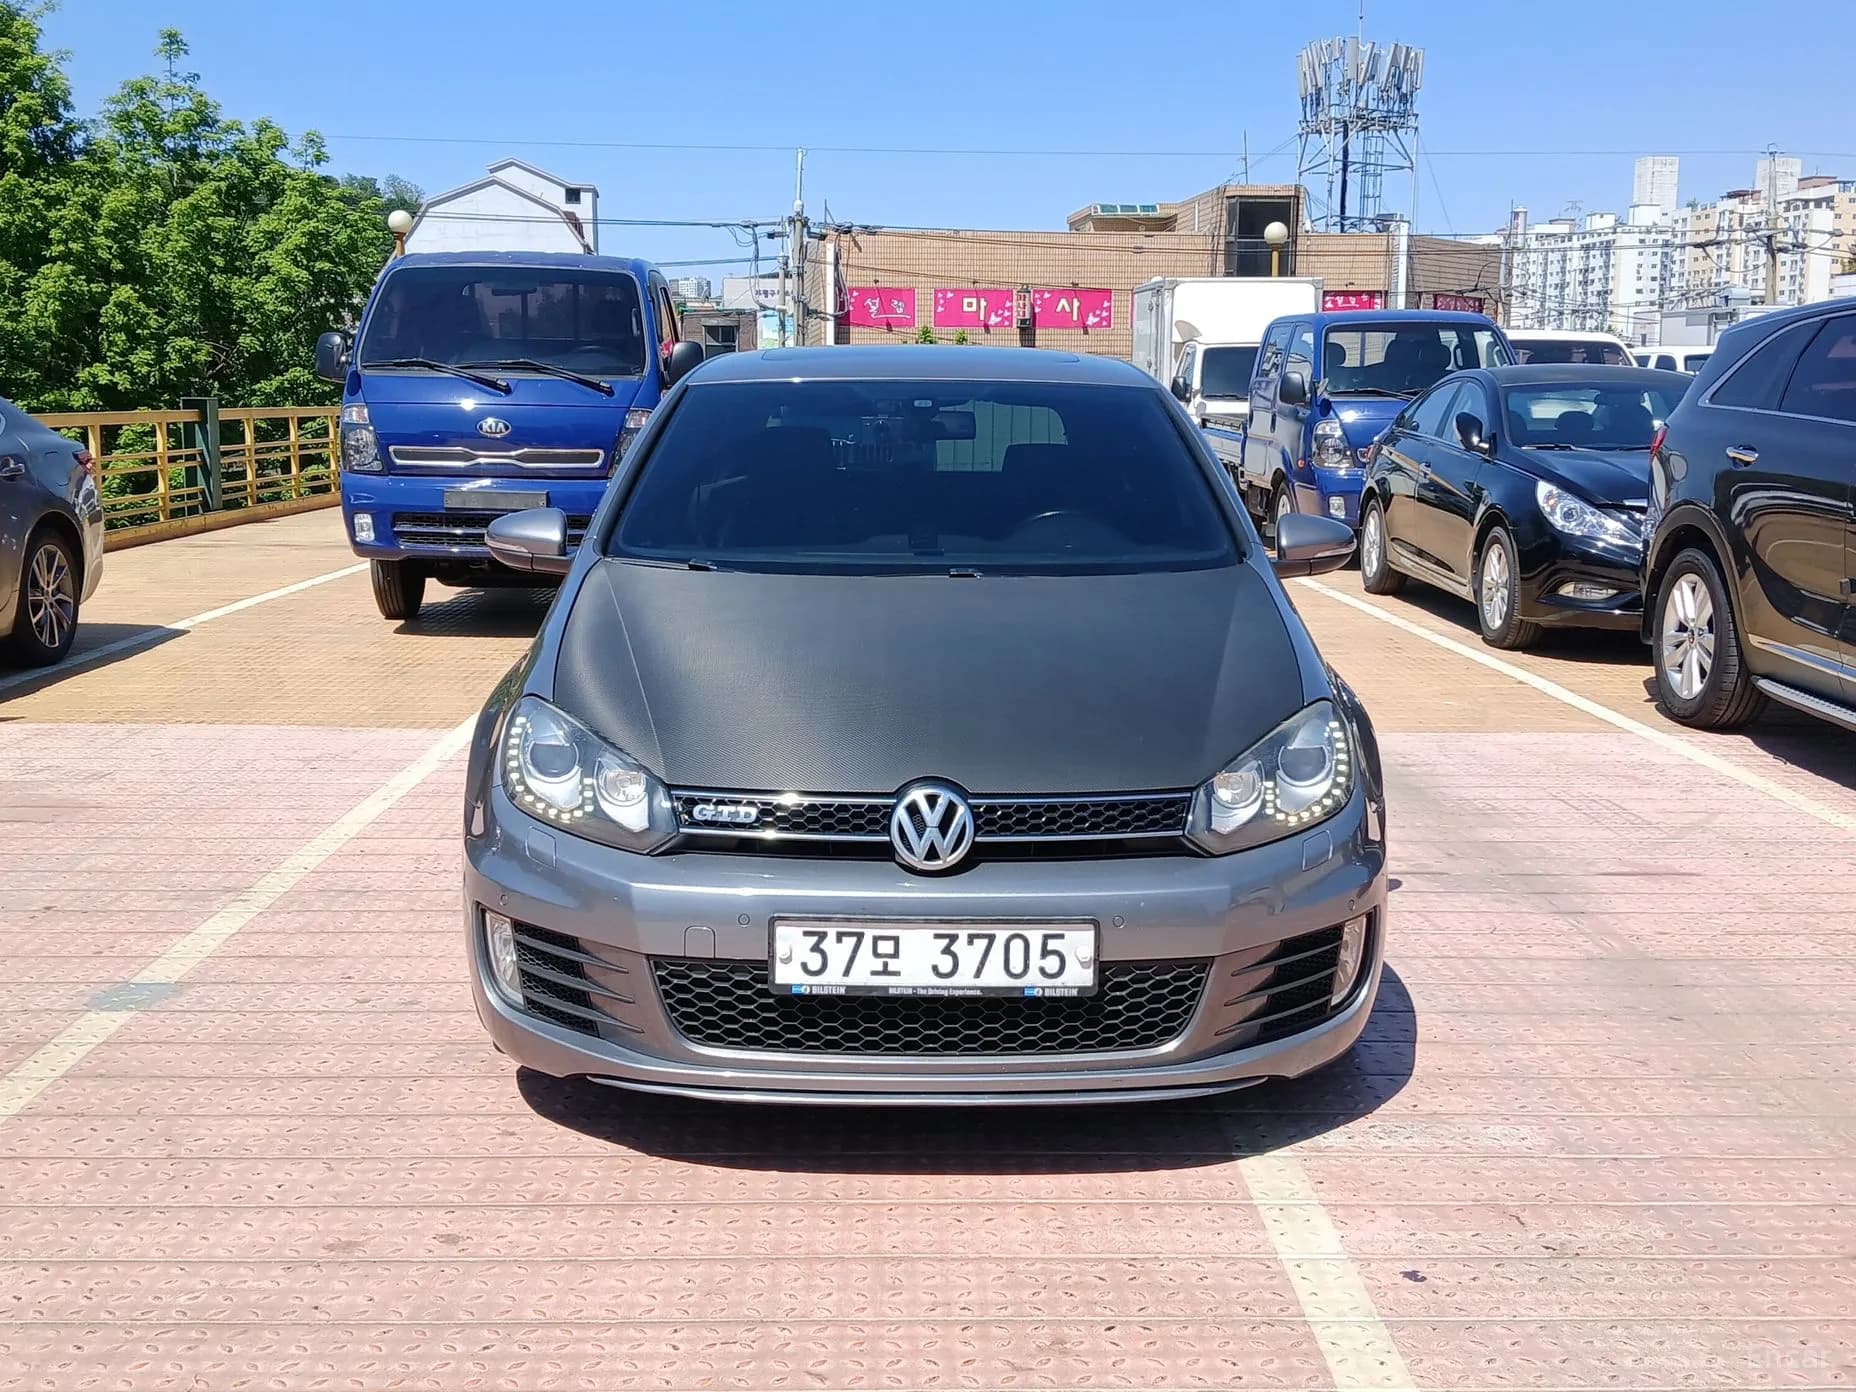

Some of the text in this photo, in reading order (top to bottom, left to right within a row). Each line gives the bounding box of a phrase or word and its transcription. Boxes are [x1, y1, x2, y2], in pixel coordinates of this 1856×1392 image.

[962, 297, 987, 321] 마
[1055, 297, 1080, 321] 사
[482, 422, 506, 433] KIA
[799, 929, 1067, 980] 37모 3705
[811, 985, 847, 995] BILSTEIN
[1044, 987, 1078, 997] BILSTEIN
